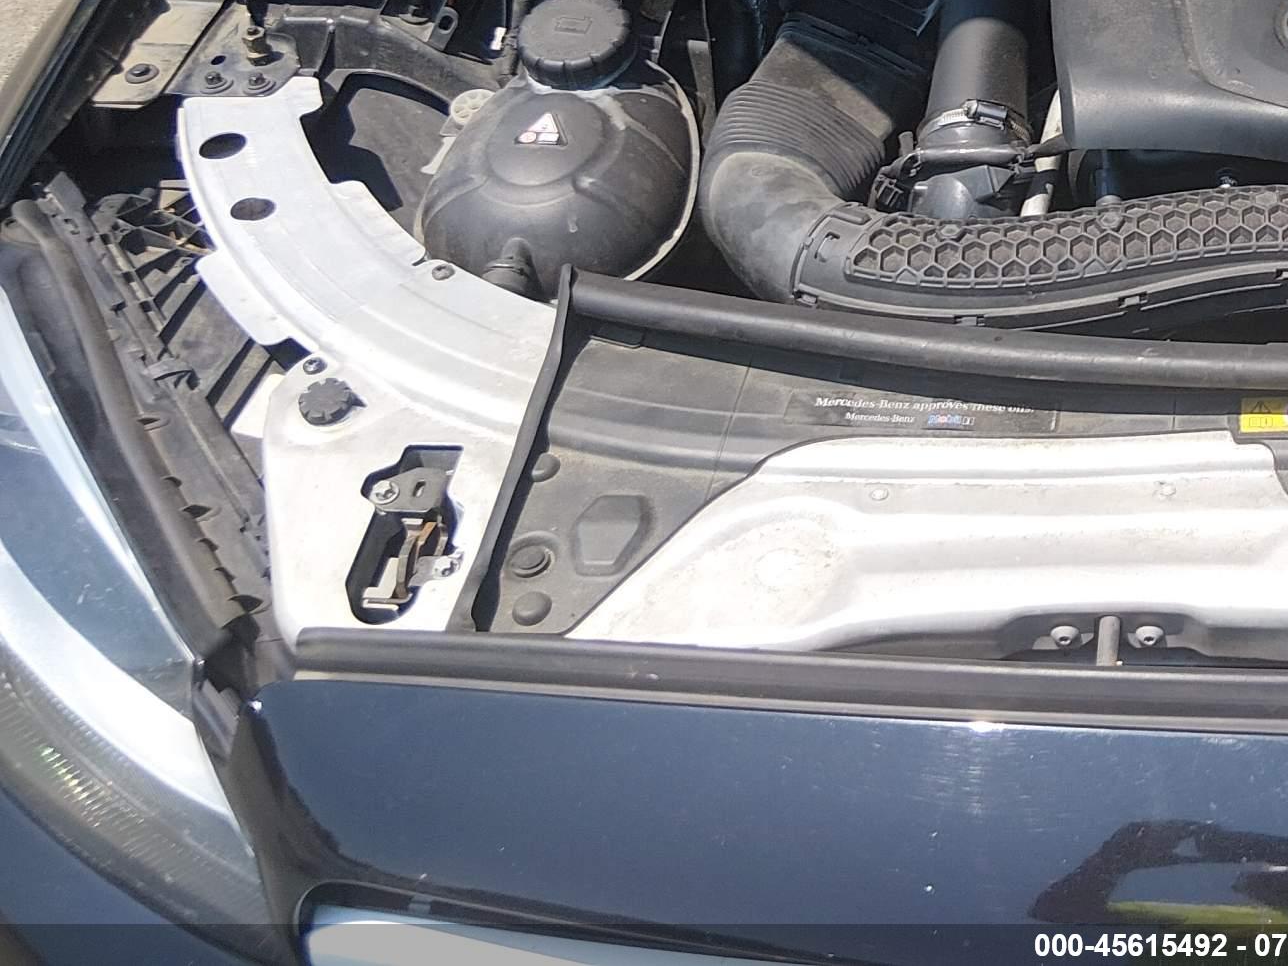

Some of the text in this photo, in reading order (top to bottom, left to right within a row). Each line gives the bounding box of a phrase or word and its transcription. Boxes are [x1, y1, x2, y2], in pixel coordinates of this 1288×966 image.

[814, 397, 911, 410] Mercedes-Benz
[911, 400, 969, 412] approves
[844, 412, 916, 424] Mercedes-Benz
